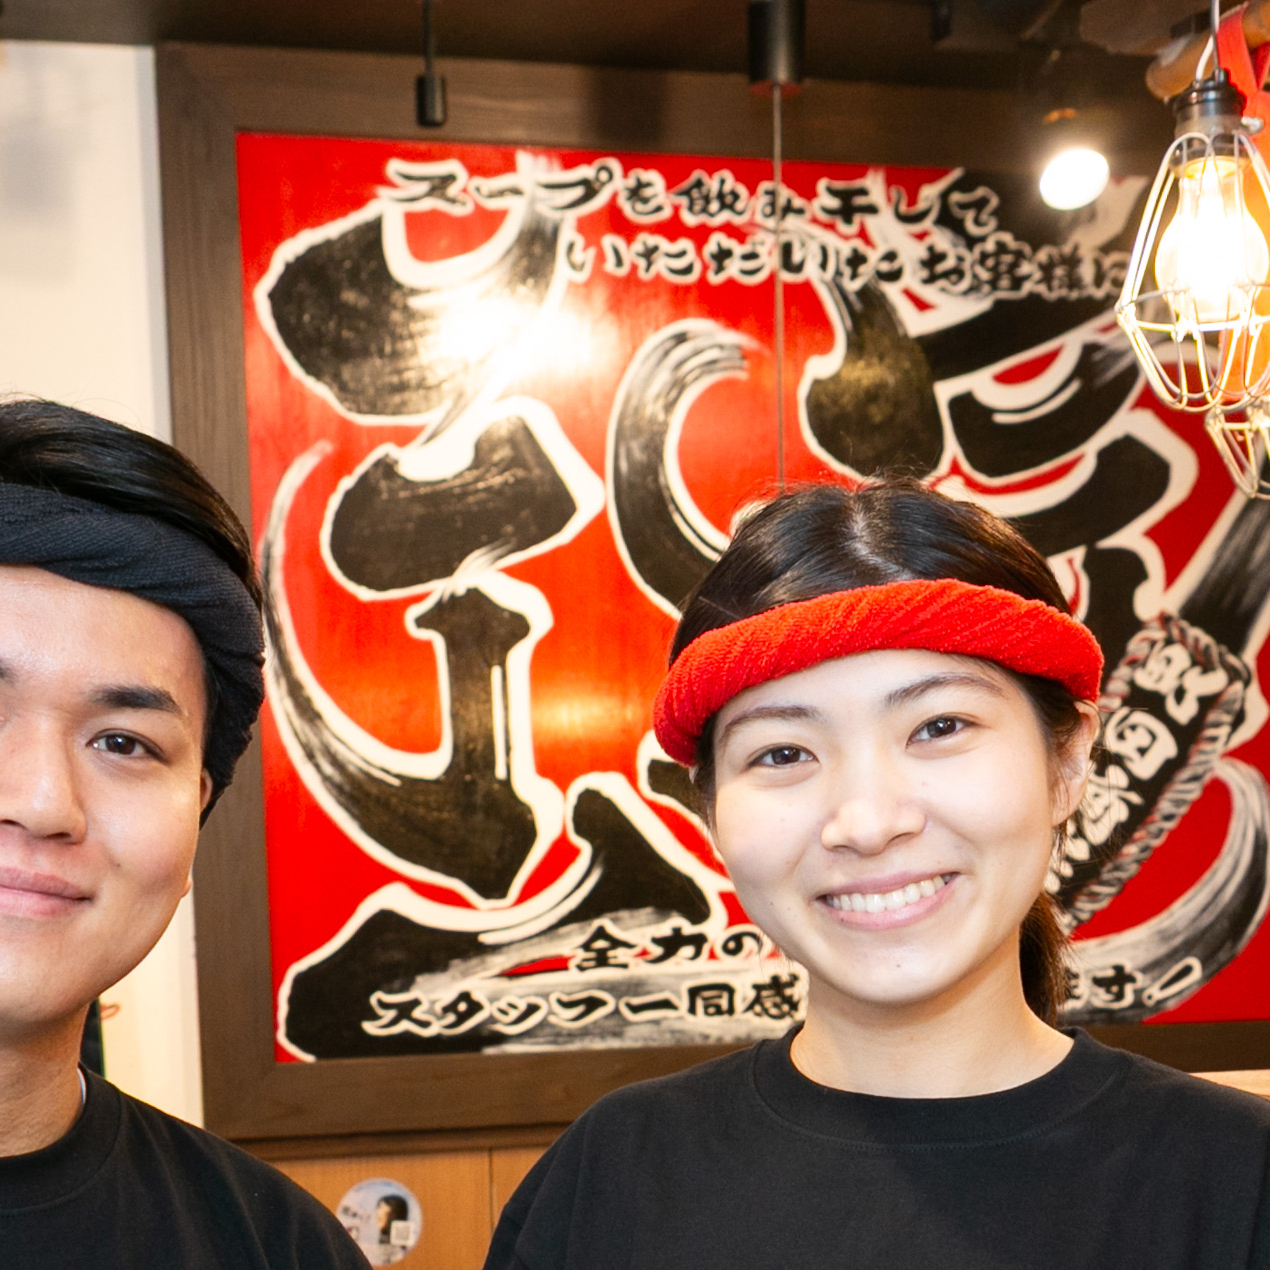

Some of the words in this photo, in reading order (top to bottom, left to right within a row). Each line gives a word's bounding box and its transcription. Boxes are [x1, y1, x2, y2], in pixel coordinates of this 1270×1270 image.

[385, 163, 997, 235] スープを飲み干して
